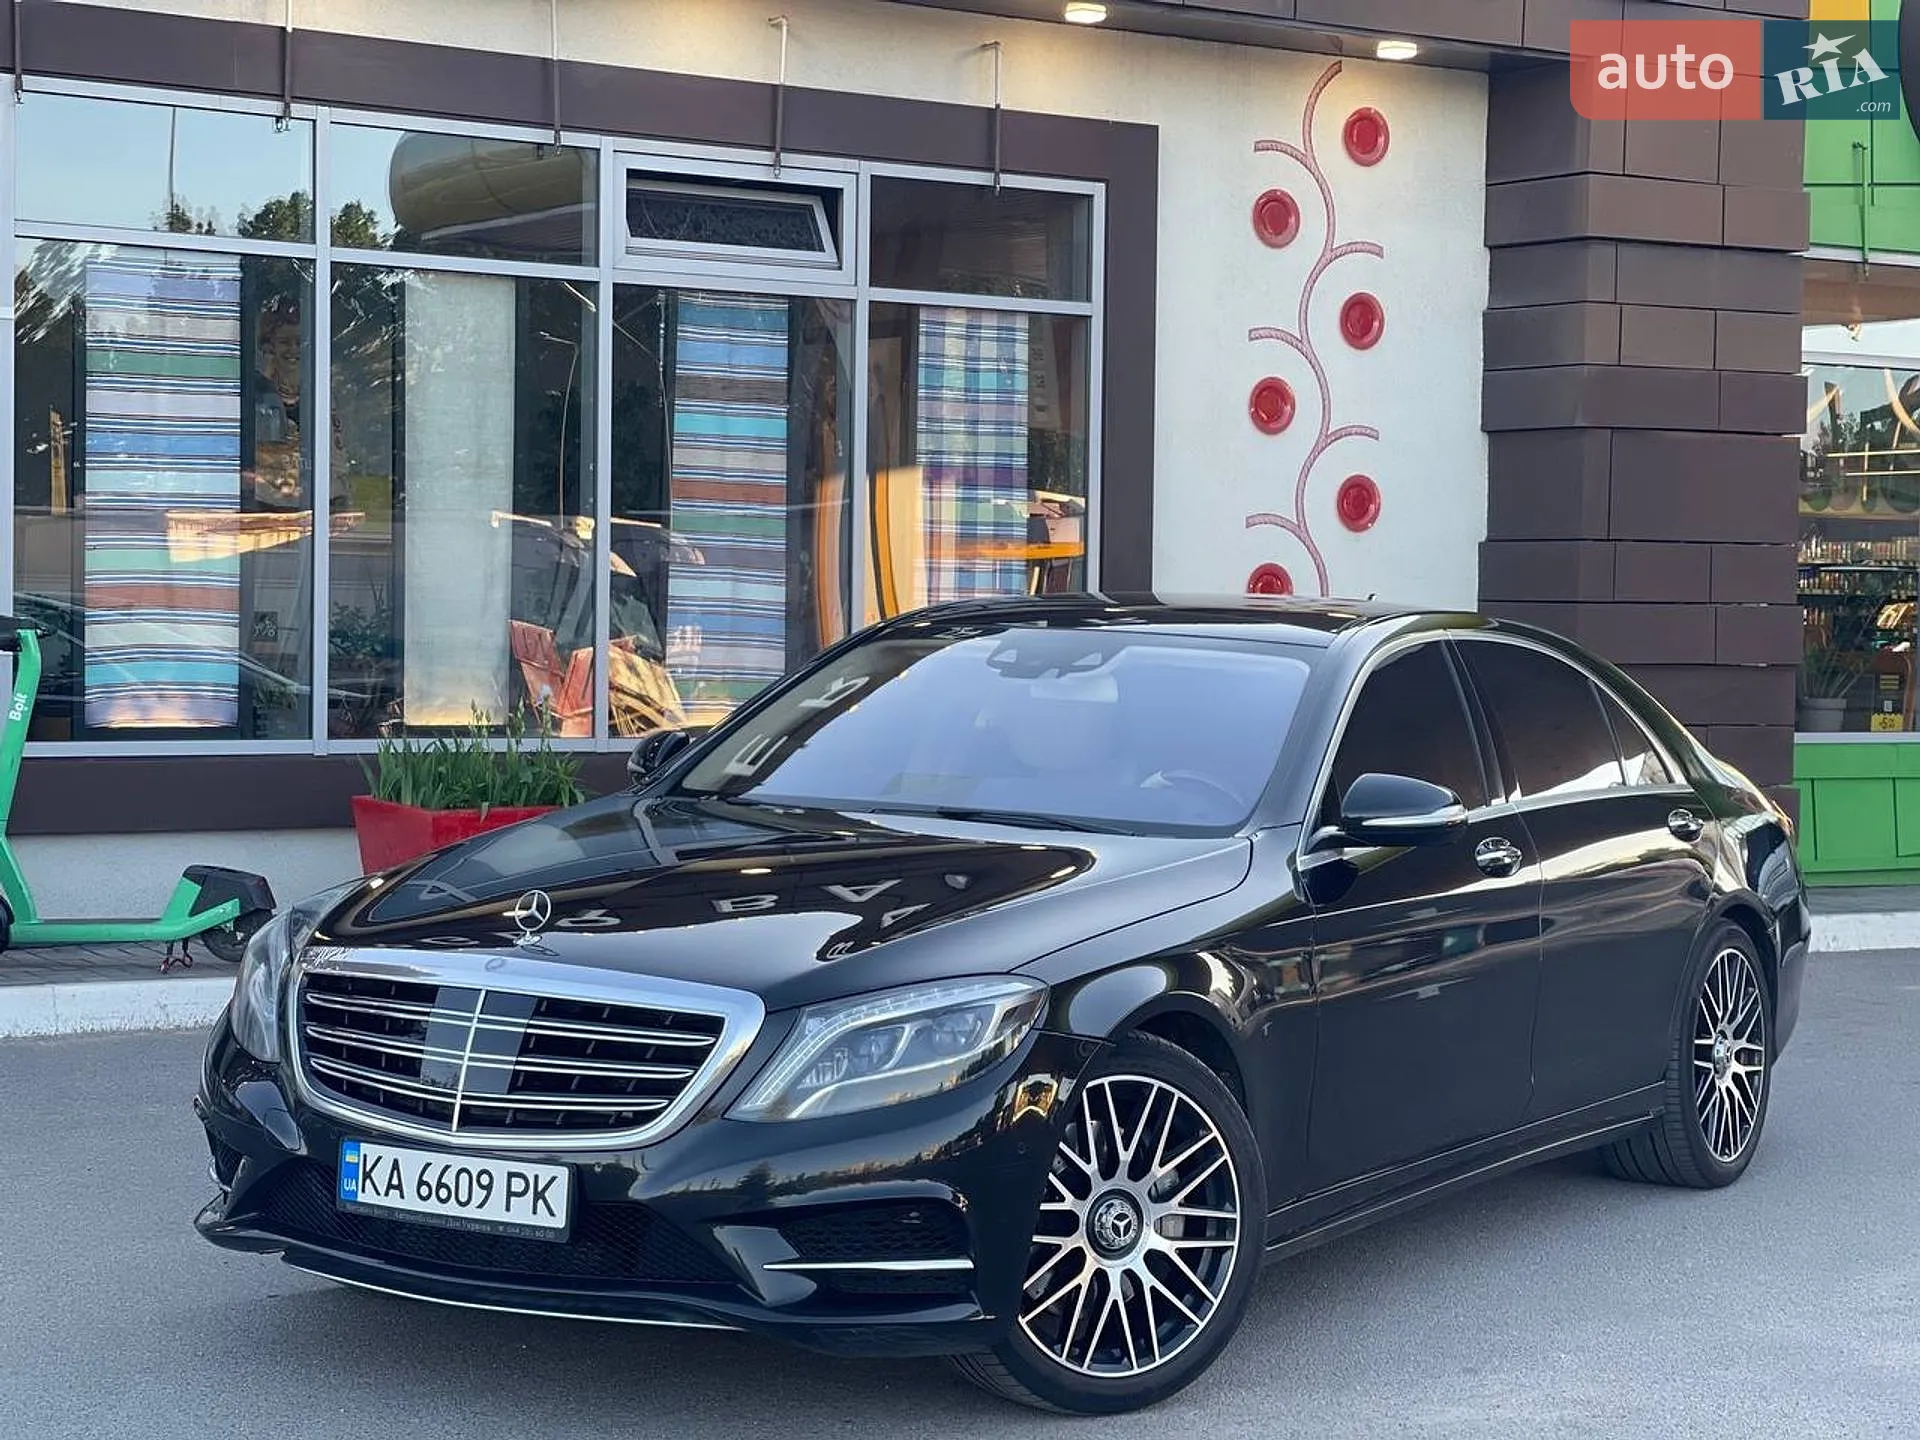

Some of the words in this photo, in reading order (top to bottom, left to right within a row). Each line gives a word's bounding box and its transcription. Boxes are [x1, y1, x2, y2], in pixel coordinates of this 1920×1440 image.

[8, 692, 28, 721] Bolt
[343, 1178, 357, 1192] UA
[361, 1153, 405, 1200] KA
[416, 1162, 494, 1209] 6609
[505, 1171, 558, 1217] PK
